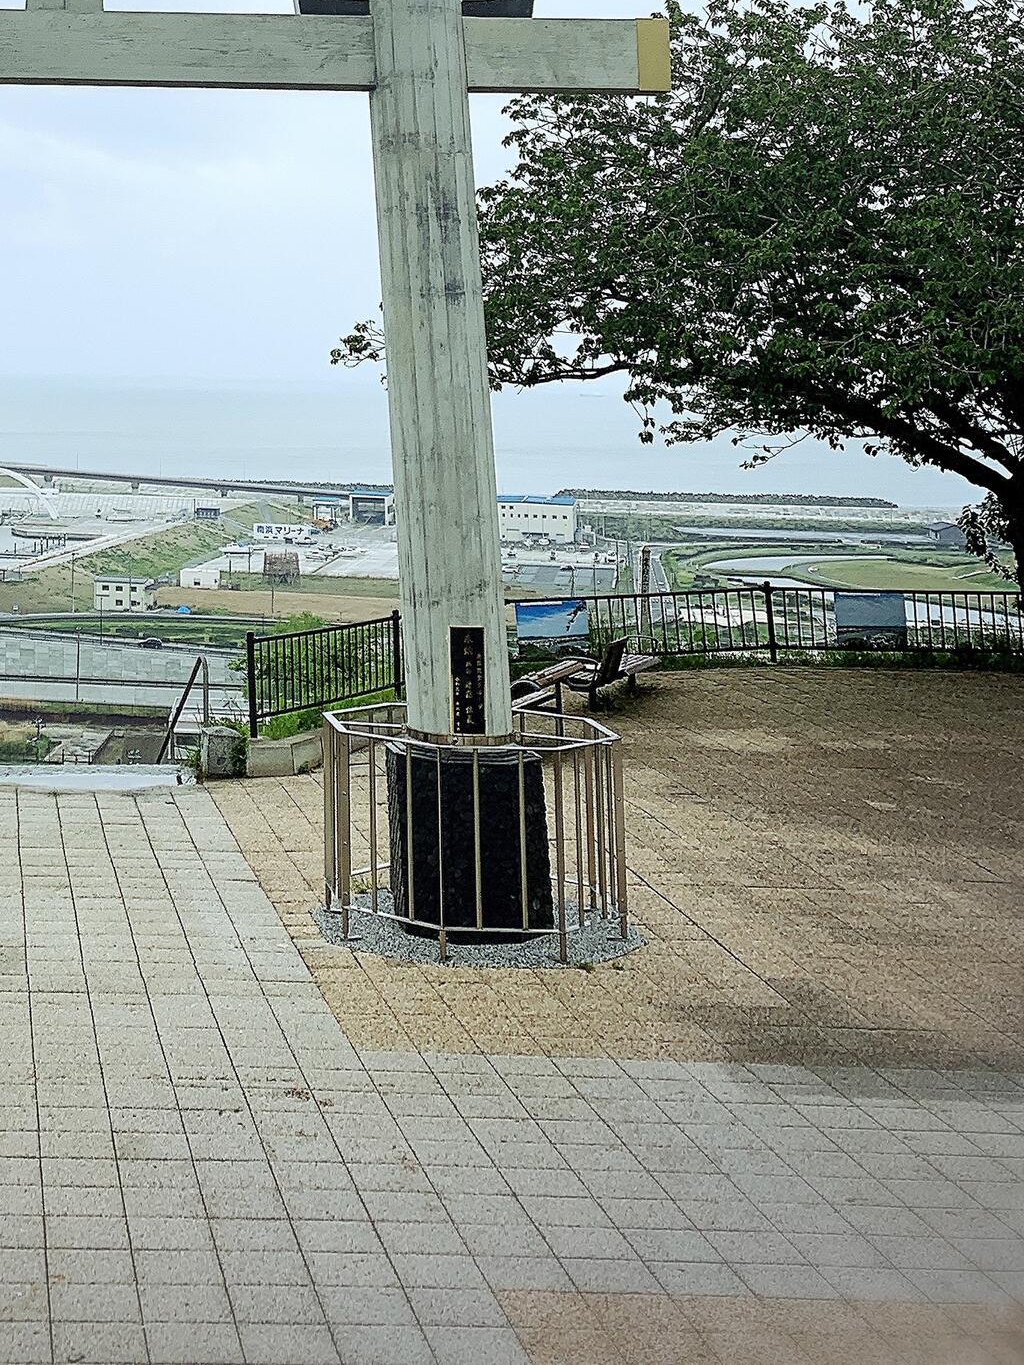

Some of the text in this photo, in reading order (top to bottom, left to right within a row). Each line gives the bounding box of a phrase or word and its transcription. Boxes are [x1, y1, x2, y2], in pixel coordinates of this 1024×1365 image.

[256, 525, 304, 535] 南浜マリーナ
